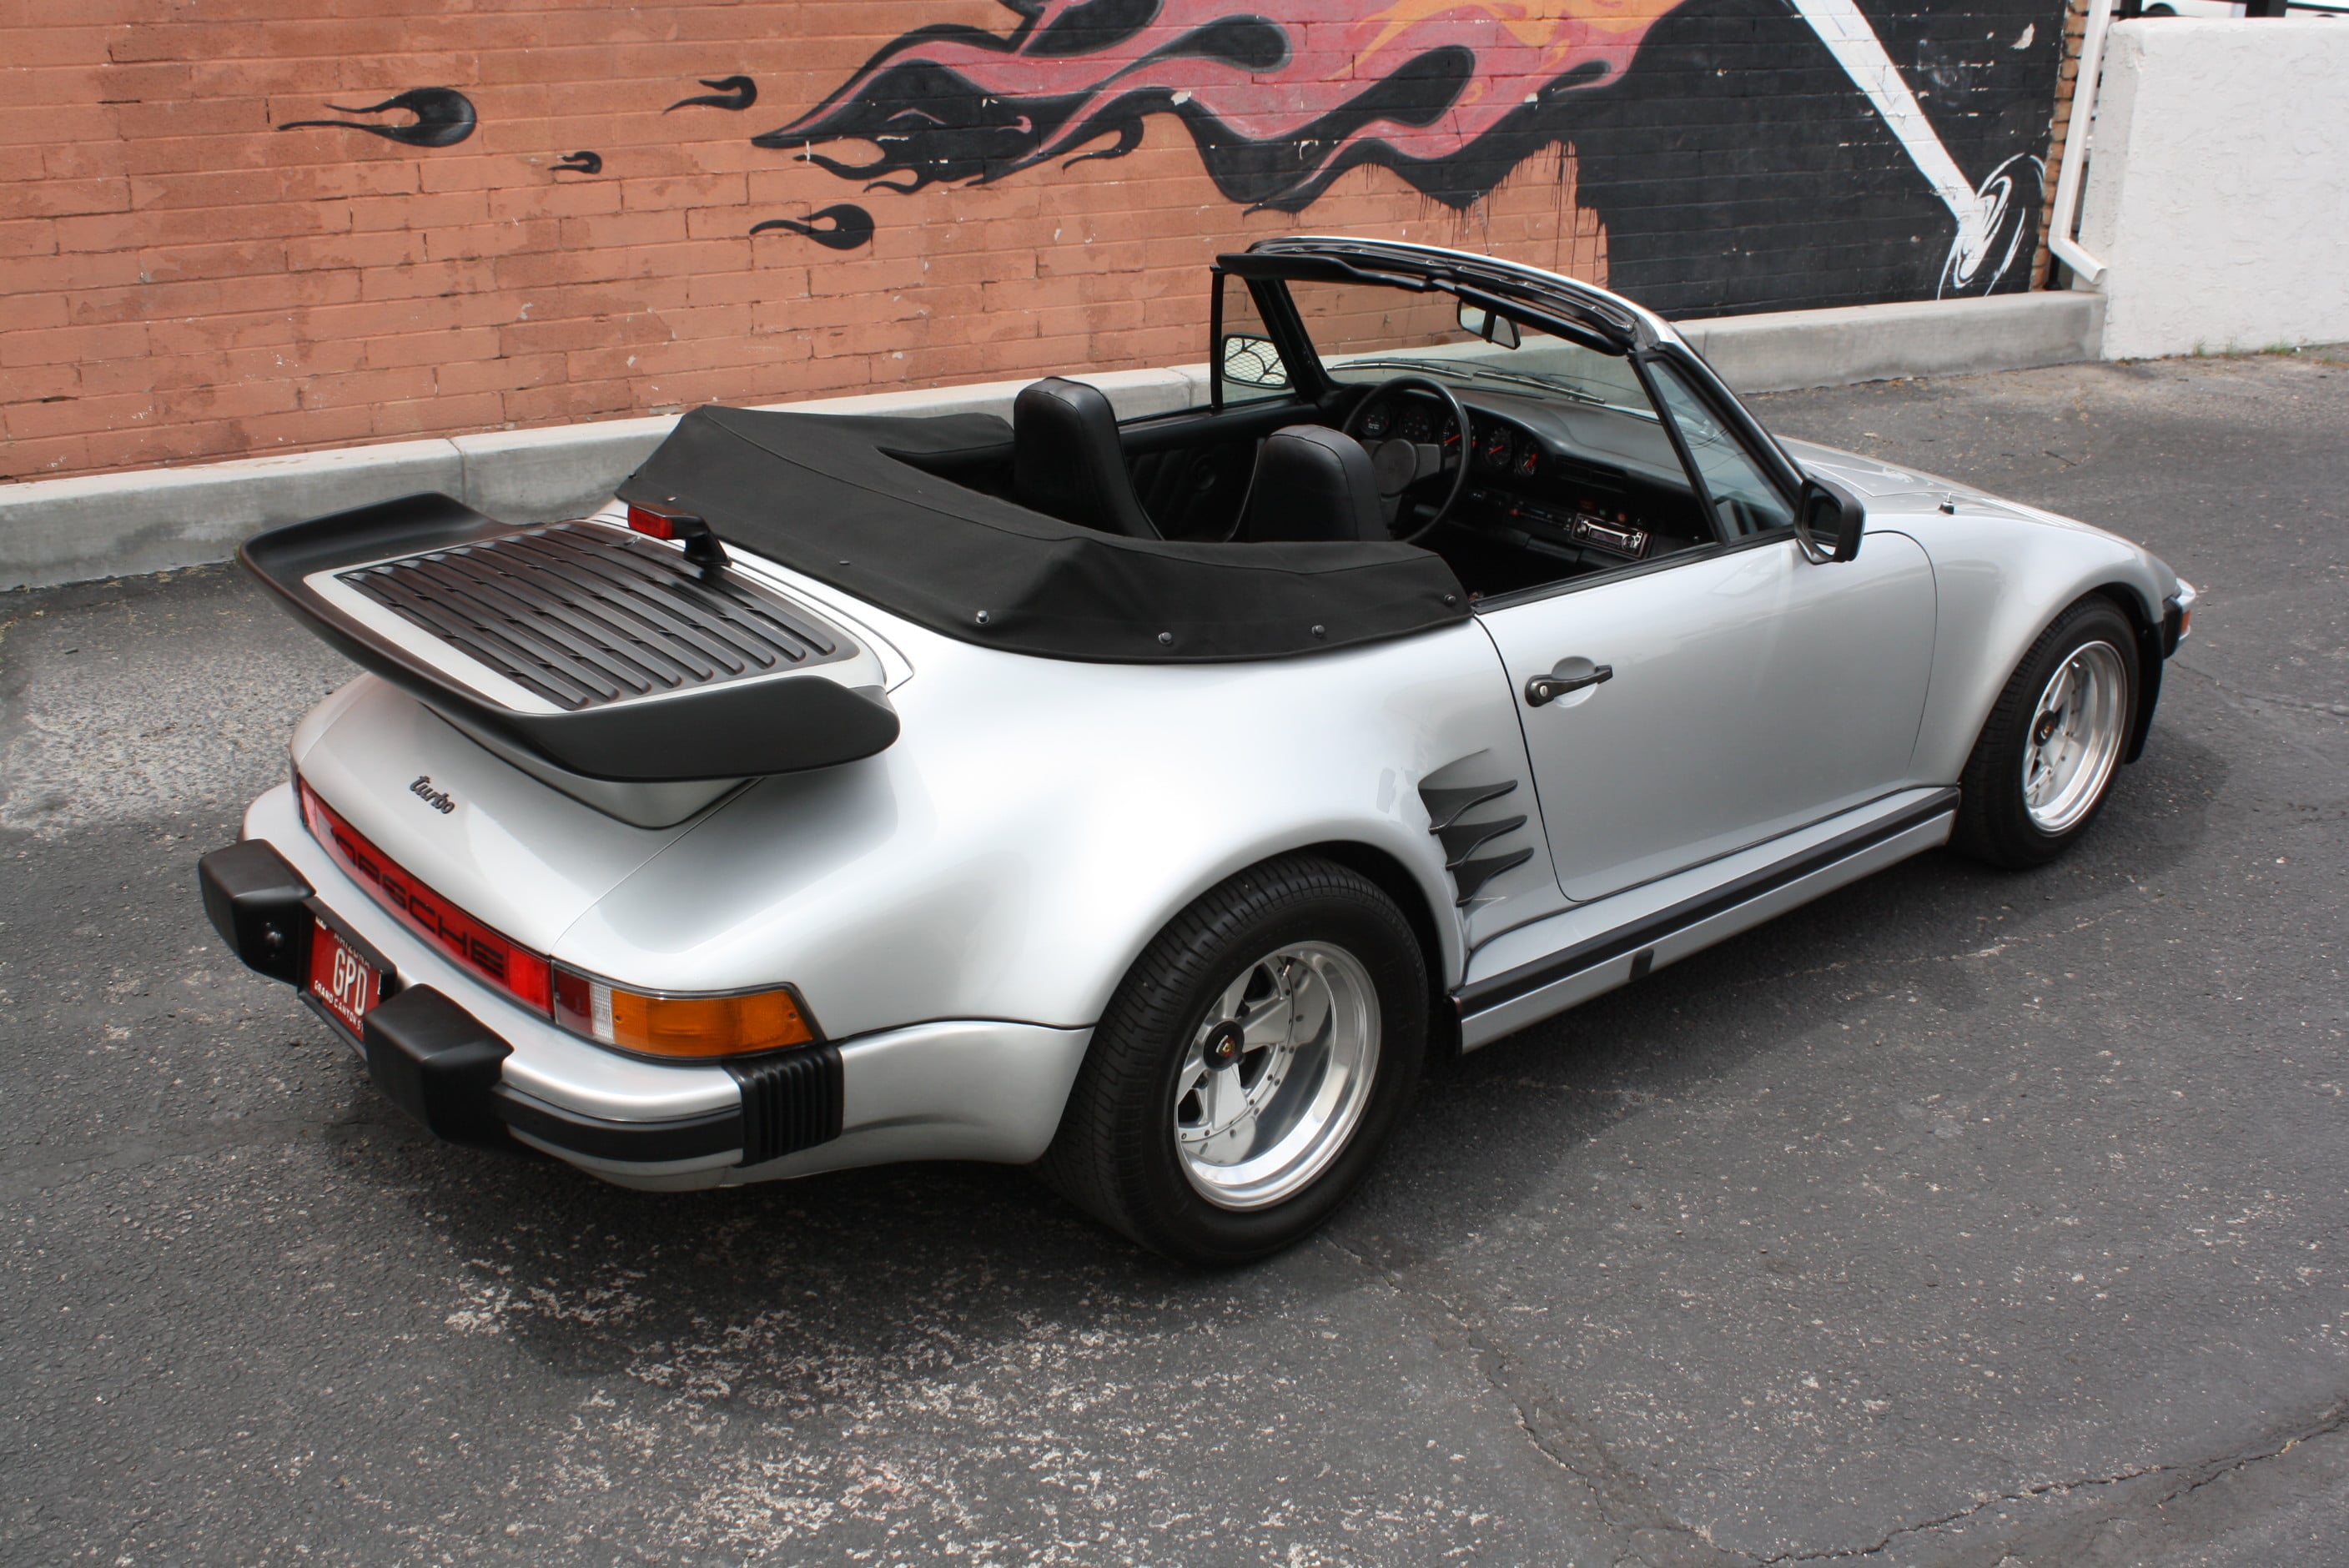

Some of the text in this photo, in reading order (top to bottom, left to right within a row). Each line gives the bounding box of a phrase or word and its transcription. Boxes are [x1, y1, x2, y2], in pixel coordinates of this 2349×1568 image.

[410, 776, 455, 814] turbo
[314, 980, 357, 1026] GRAND CANYON
[333, 947, 368, 1016] GPD
